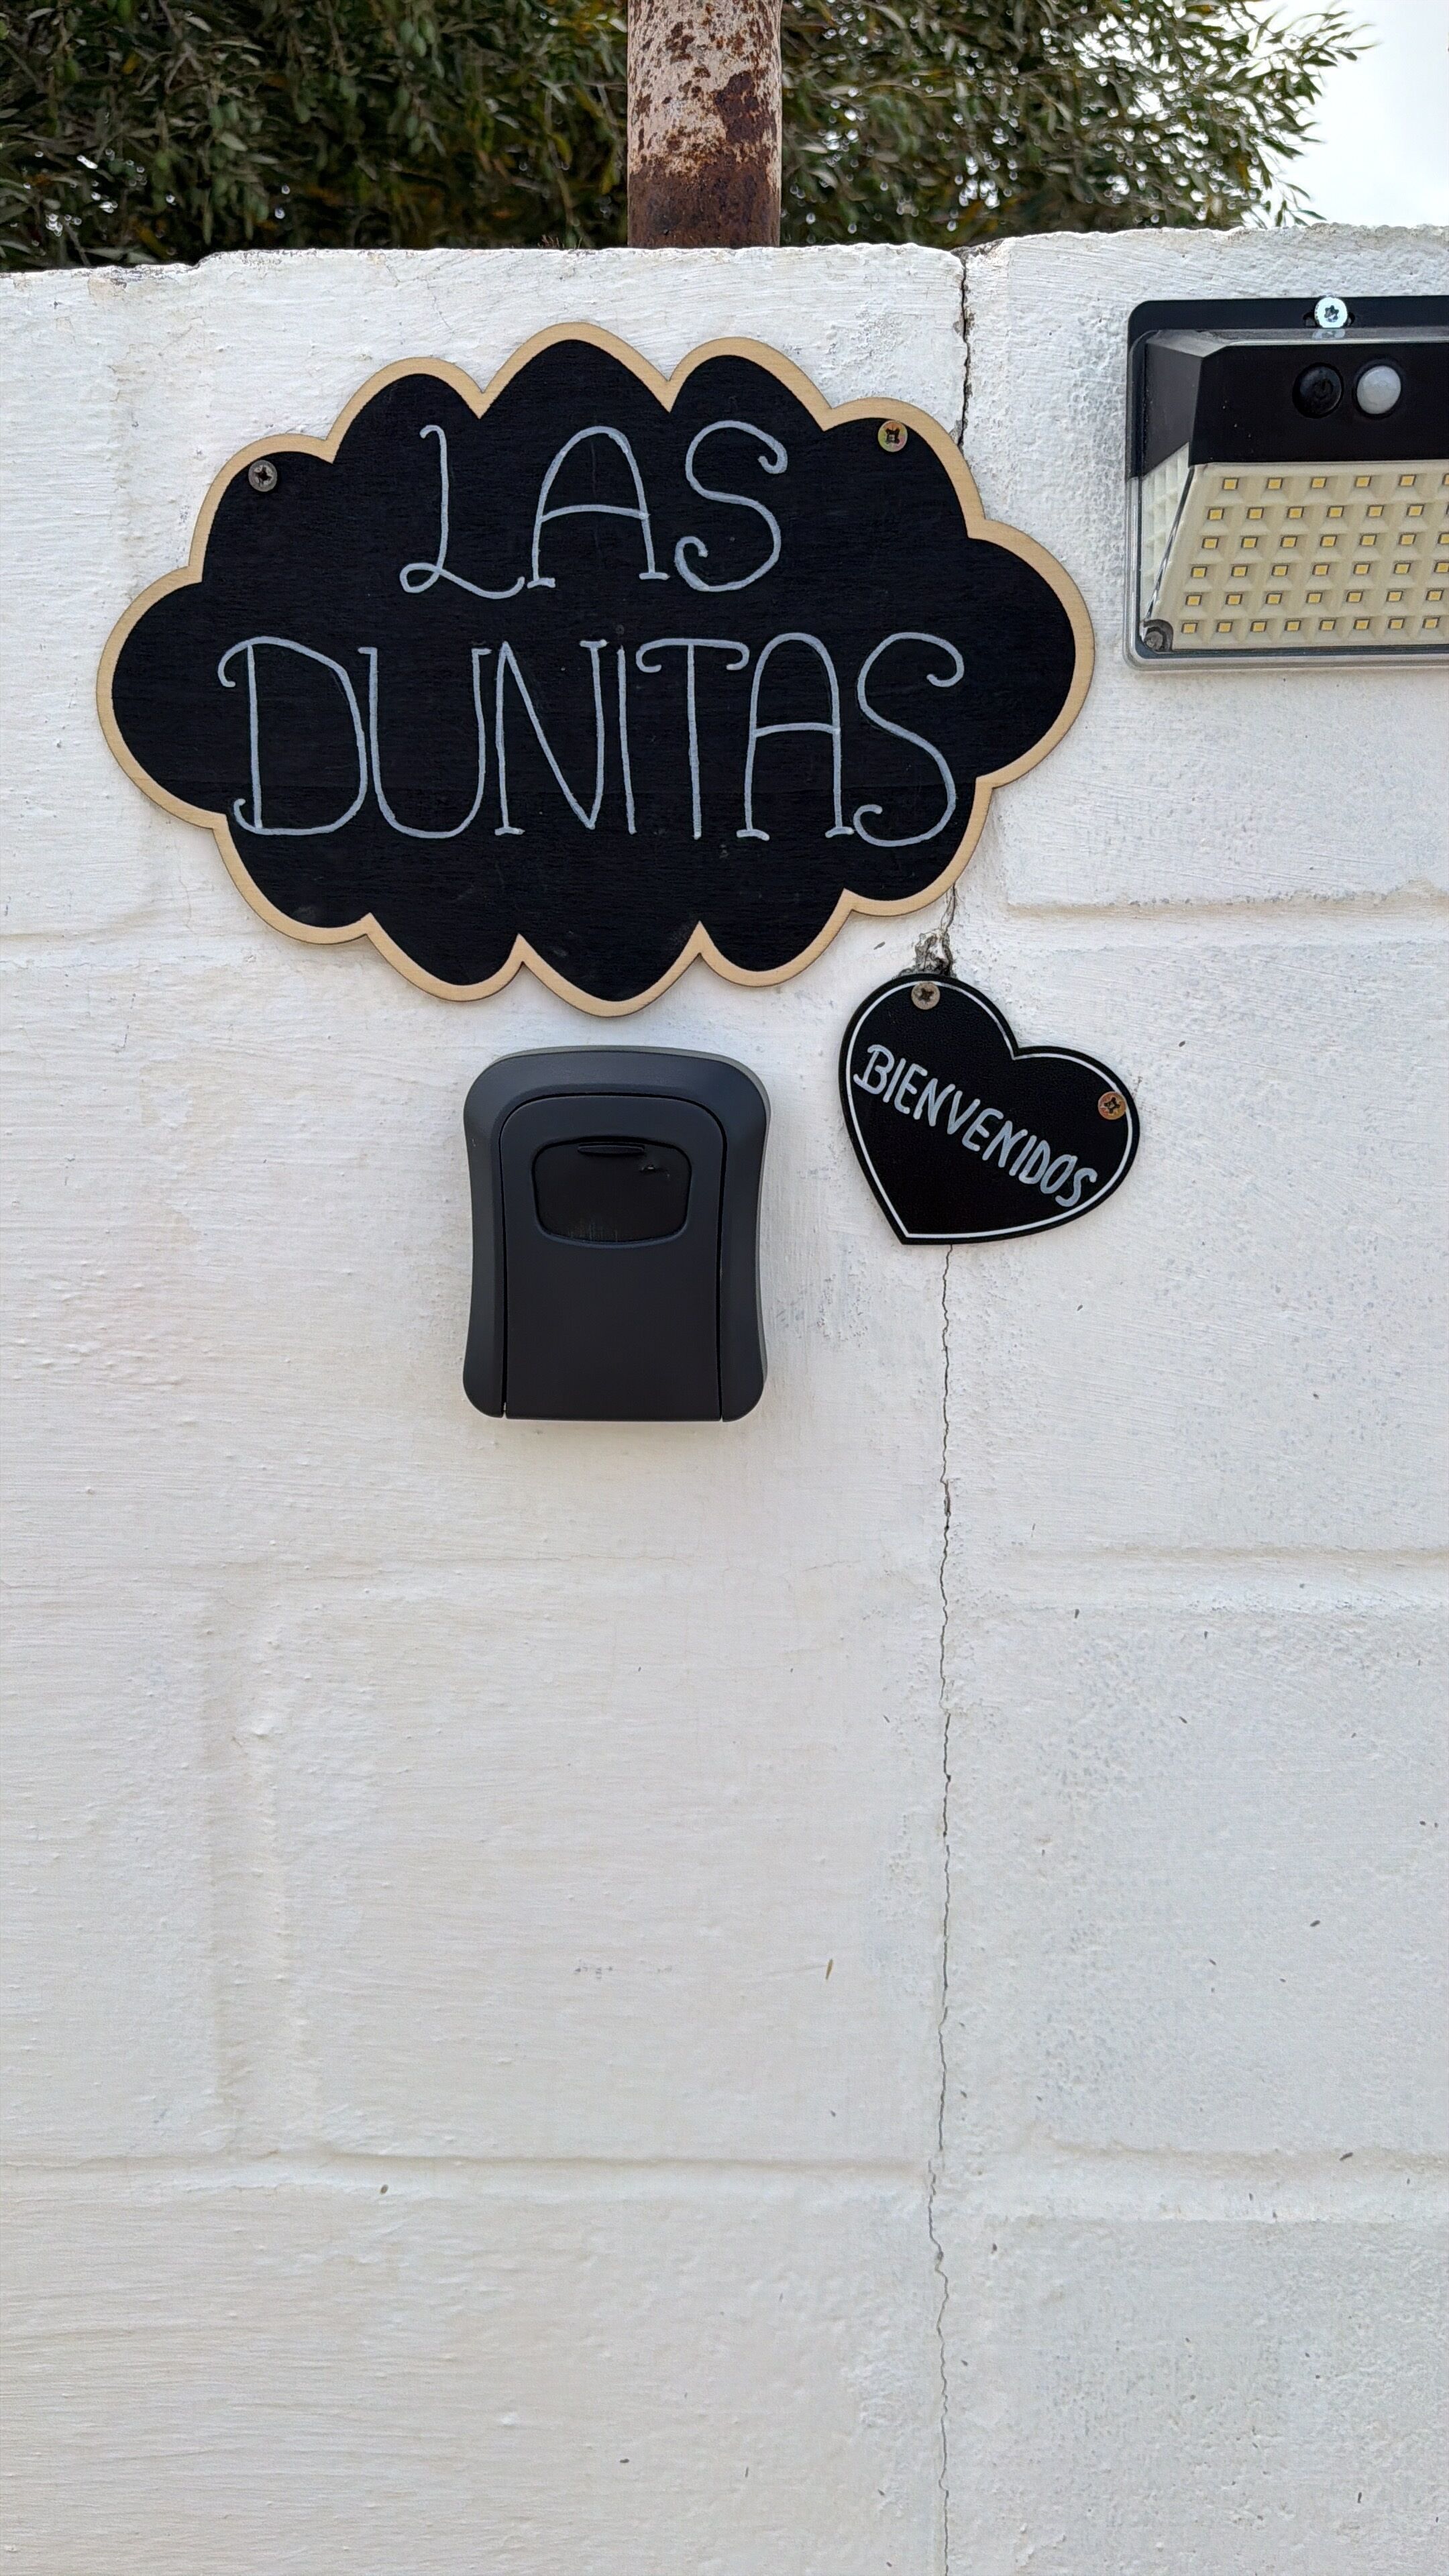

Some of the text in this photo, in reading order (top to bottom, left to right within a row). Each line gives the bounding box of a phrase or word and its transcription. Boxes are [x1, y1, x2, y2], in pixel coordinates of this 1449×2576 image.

[399, 420, 788, 600] LAS
[217, 632, 965, 847] DUNITAS
[853, 1044, 1098, 1208] BIENVENIDOS
